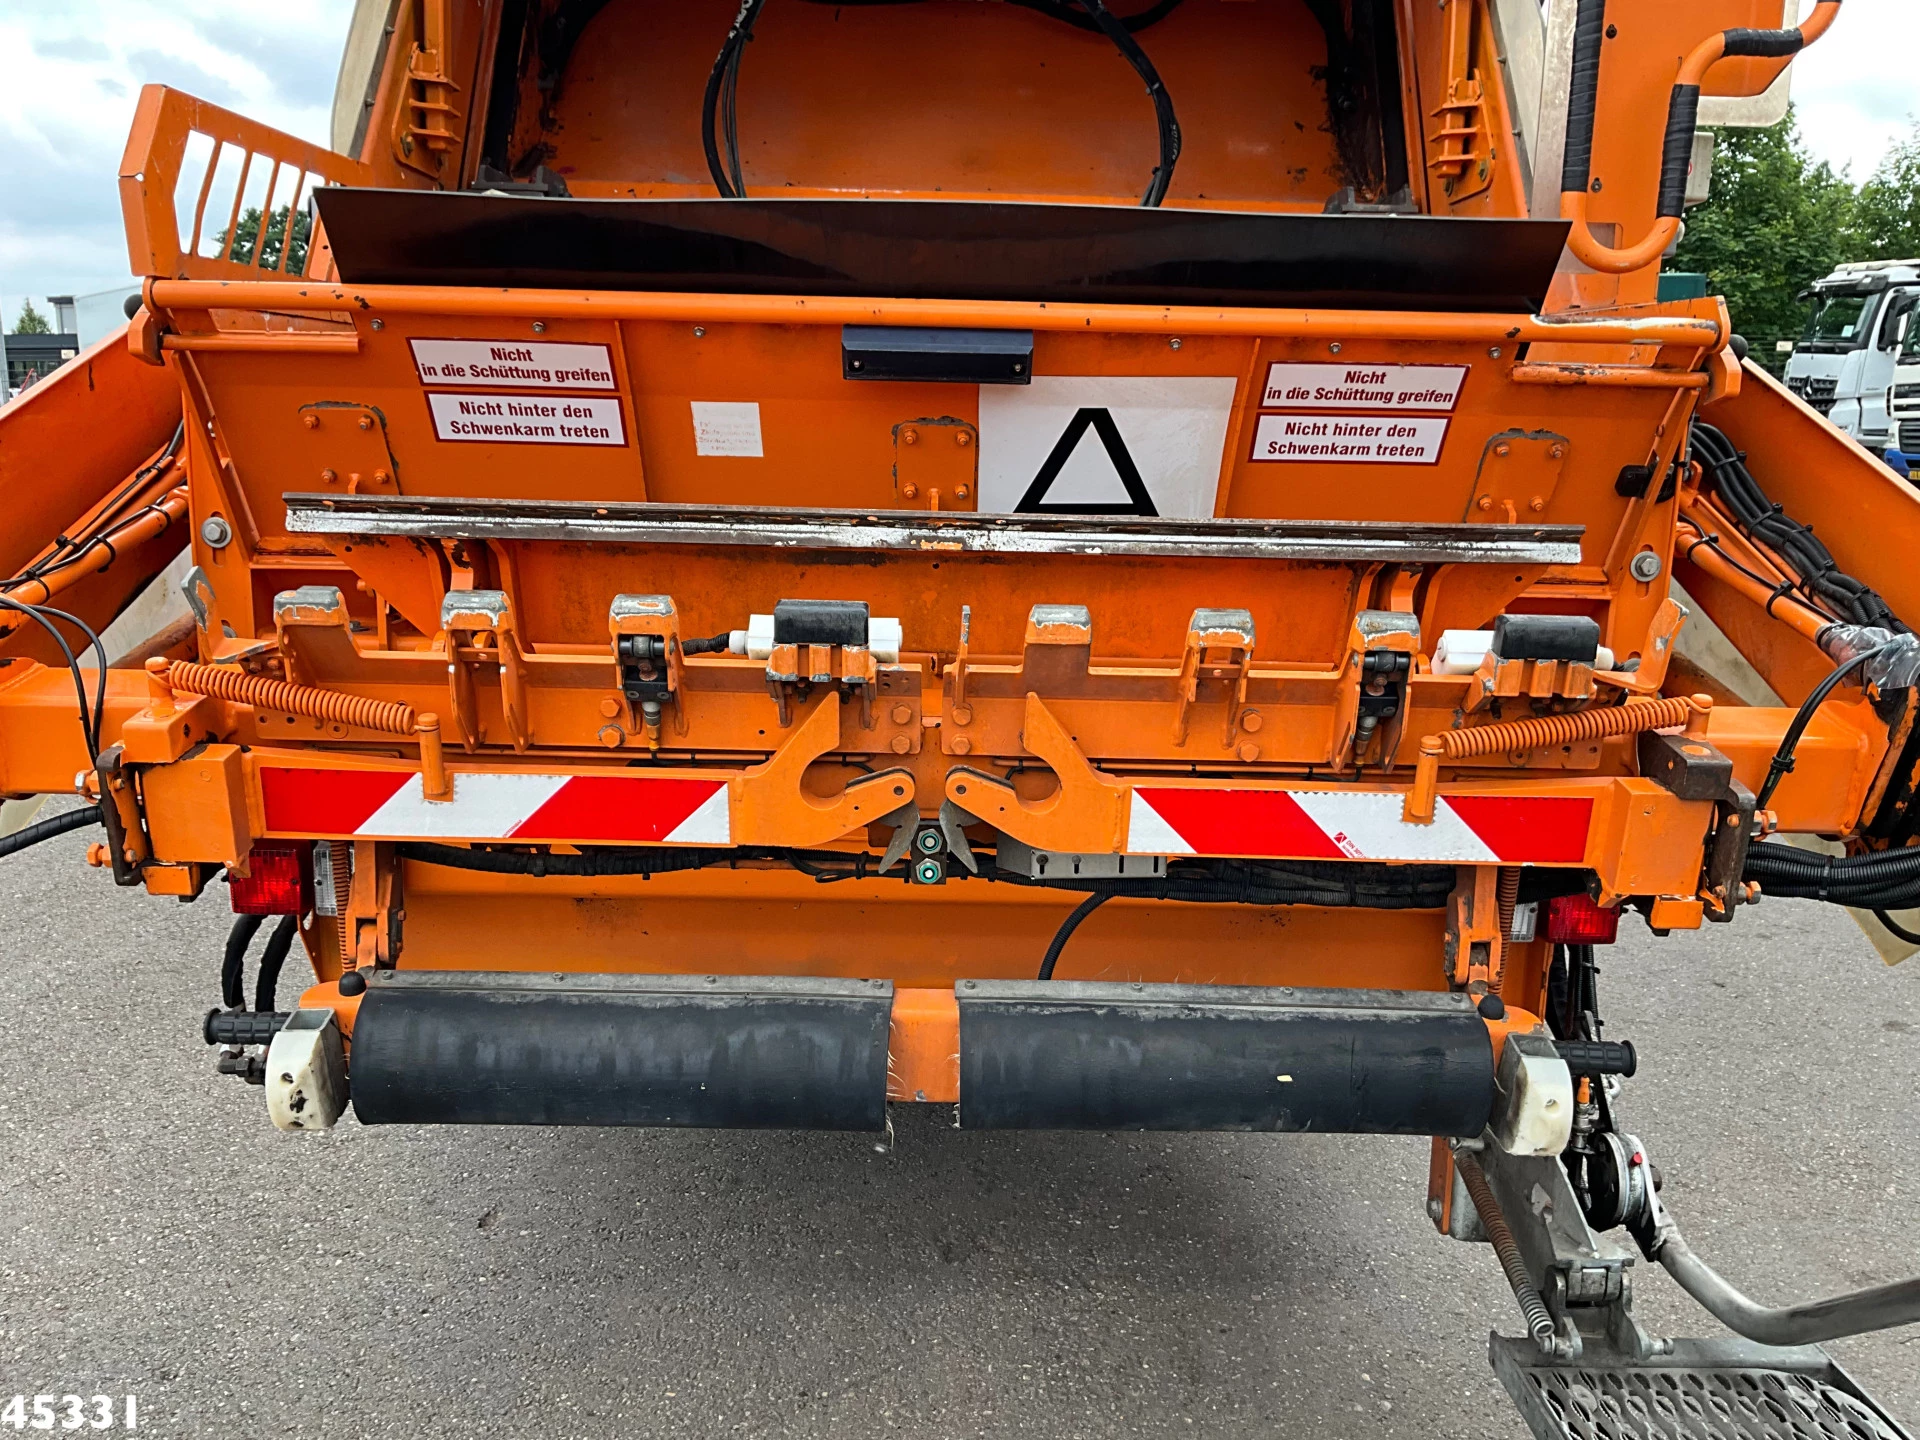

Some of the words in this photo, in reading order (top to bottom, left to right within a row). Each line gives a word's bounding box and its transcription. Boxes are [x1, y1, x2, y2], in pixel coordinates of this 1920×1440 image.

[490, 348, 534, 362] Nicht
[421, 363, 438, 377] in
[441, 364, 466, 377] die
[469, 364, 551, 382] Schüttung
[555, 366, 610, 383] greifen
[1344, 371, 1387, 384] Nicht
[1267, 387, 1281, 399] in
[1286, 387, 1310, 400] die
[1314, 387, 1394, 404] Schüttung
[1397, 390, 1453, 404] greifen
[459, 402, 503, 415] Nicht
[508, 403, 556, 417] hinter
[563, 405, 592, 418] den
[450, 421, 555, 436] Schwenkarm
[560, 425, 609, 438] treten
[1285, 422, 1328, 435] Nicht
[1333, 423, 1382, 436] hinter
[1387, 424, 1416, 437] den
[1268, 441, 1370, 455] Schwenkarm
[1377, 444, 1424, 456] treten
